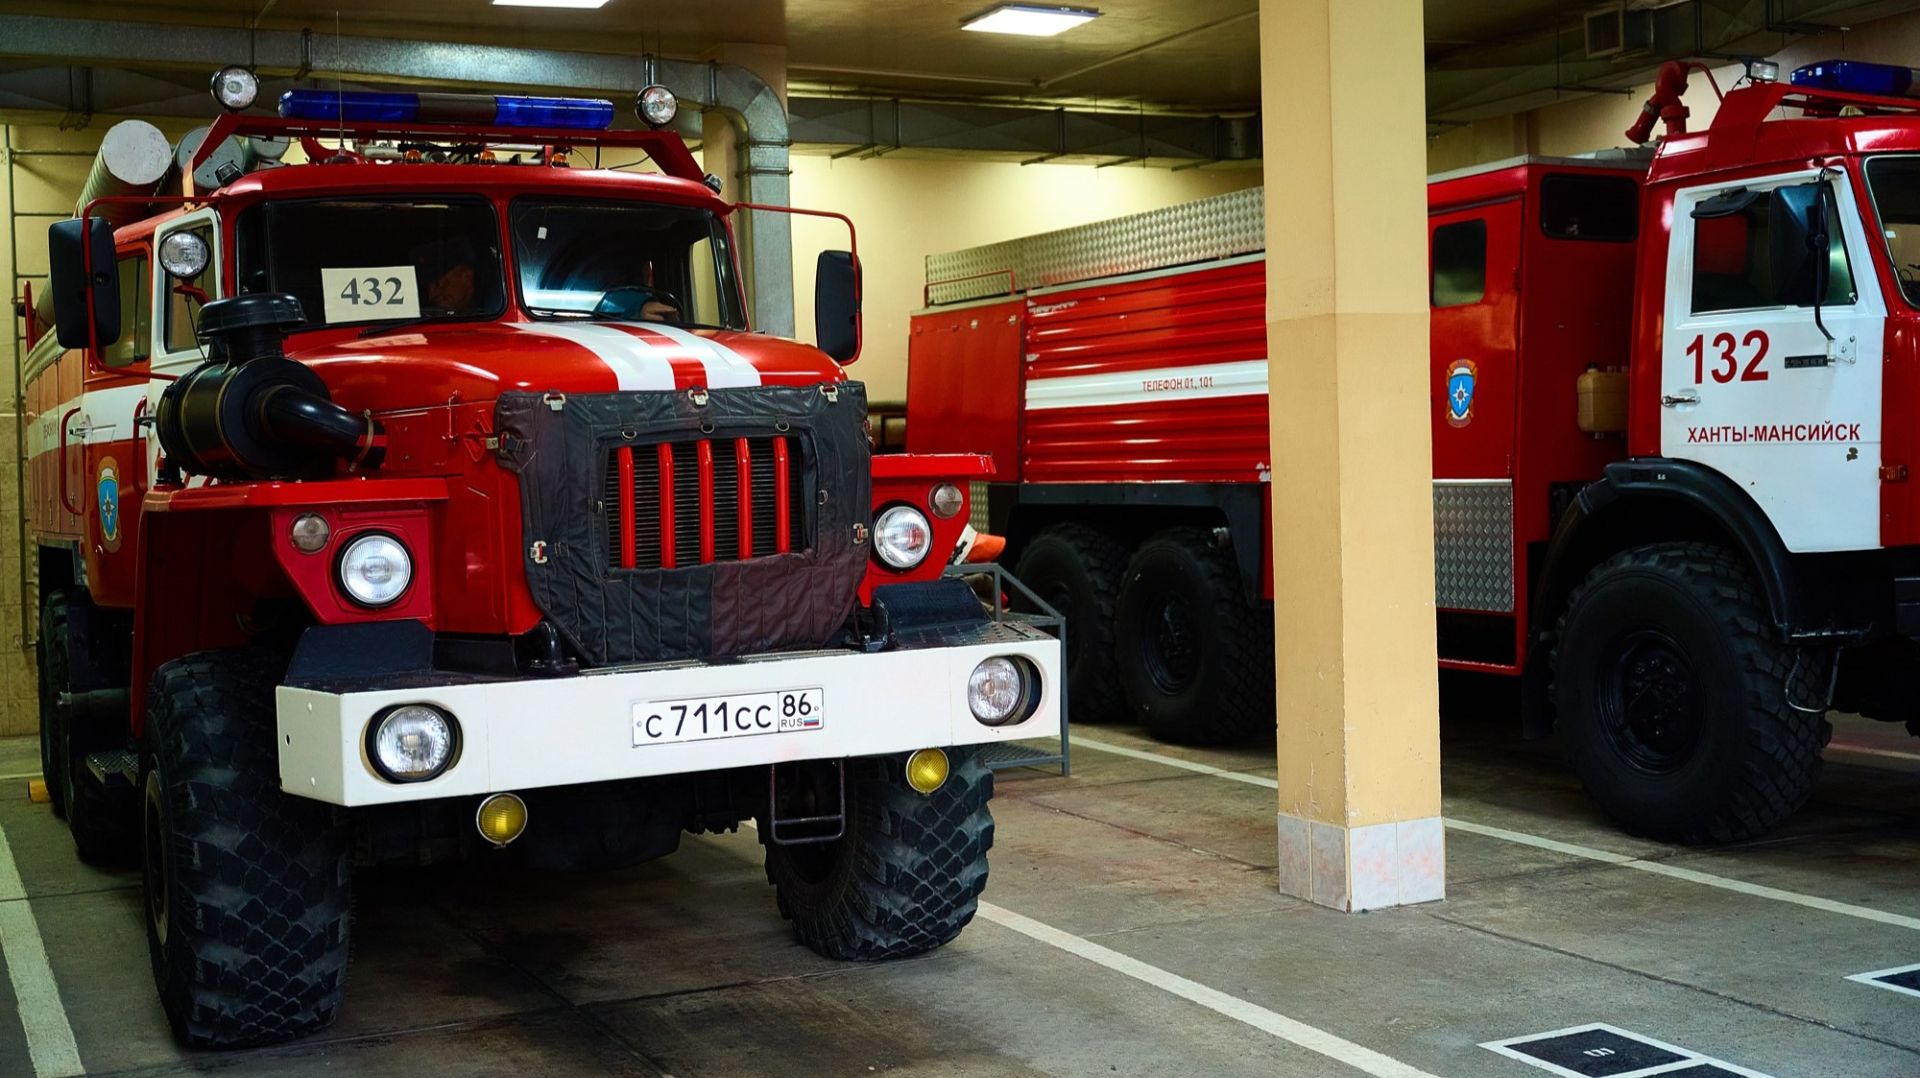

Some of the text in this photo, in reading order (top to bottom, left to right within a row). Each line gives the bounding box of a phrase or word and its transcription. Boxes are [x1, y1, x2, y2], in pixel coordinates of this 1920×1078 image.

[340, 276, 405, 306] 432
[1685, 329, 1770, 385] 132
[1142, 378, 1183, 393] ТЕЛЕФОН
[1199, 375, 1214, 389] 101
[1687, 420, 1861, 443] ХАНТЫ-МАНСИЙСК
[782, 693, 813, 718] 86
[780, 718, 803, 729] RUS
